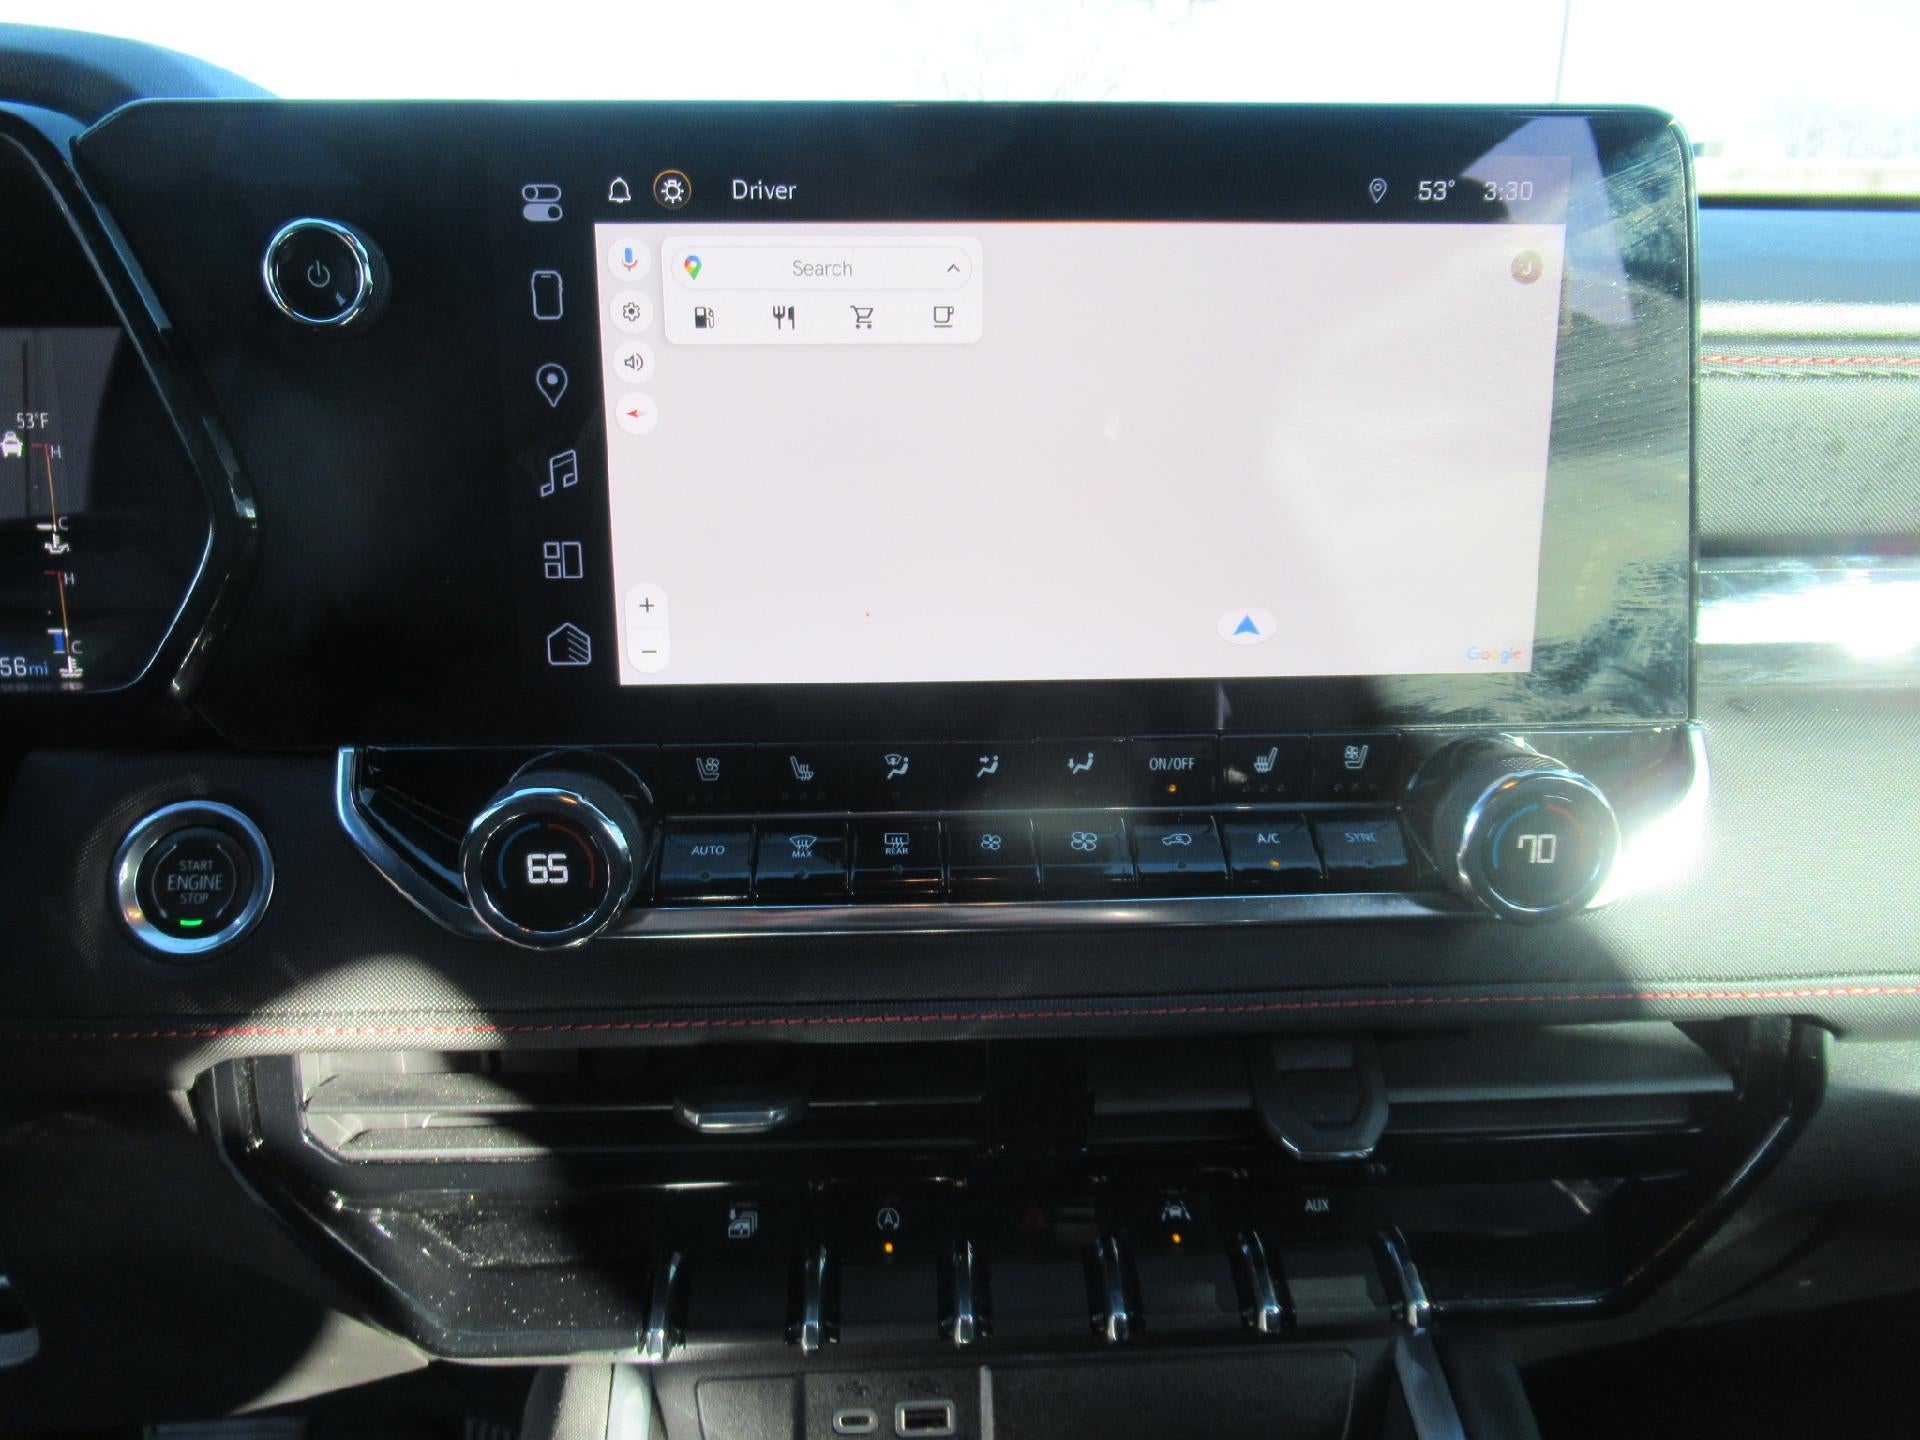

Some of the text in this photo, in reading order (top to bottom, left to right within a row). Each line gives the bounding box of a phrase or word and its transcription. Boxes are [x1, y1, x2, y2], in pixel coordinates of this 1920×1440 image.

[731, 179, 797, 201] Driver
[1417, 179, 1534, 201] 53° 3:30
[792, 258, 853, 278] Search
[16, 412, 49, 429] 53°F
[50, 445, 62, 458] H
[57, 516, 69, 531] C
[64, 571, 75, 585] H
[71, 640, 83, 654] C
[1466, 646, 1521, 664] Google
[1149, 756, 1196, 772] ON/OFF
[1257, 832, 1280, 844] A/C
[1344, 832, 1377, 842] SYNC
[691, 844, 726, 857] AUTO
[791, 849, 813, 859] MAX
[884, 847, 910, 857] REAR
[1517, 833, 1556, 864] 70
[178, 860, 214, 872] START
[526, 853, 569, 885] 65
[167, 874, 223, 891] ENGINE
[179, 893, 209, 904] STOP
[1304, 1198, 1330, 1212] AUX
